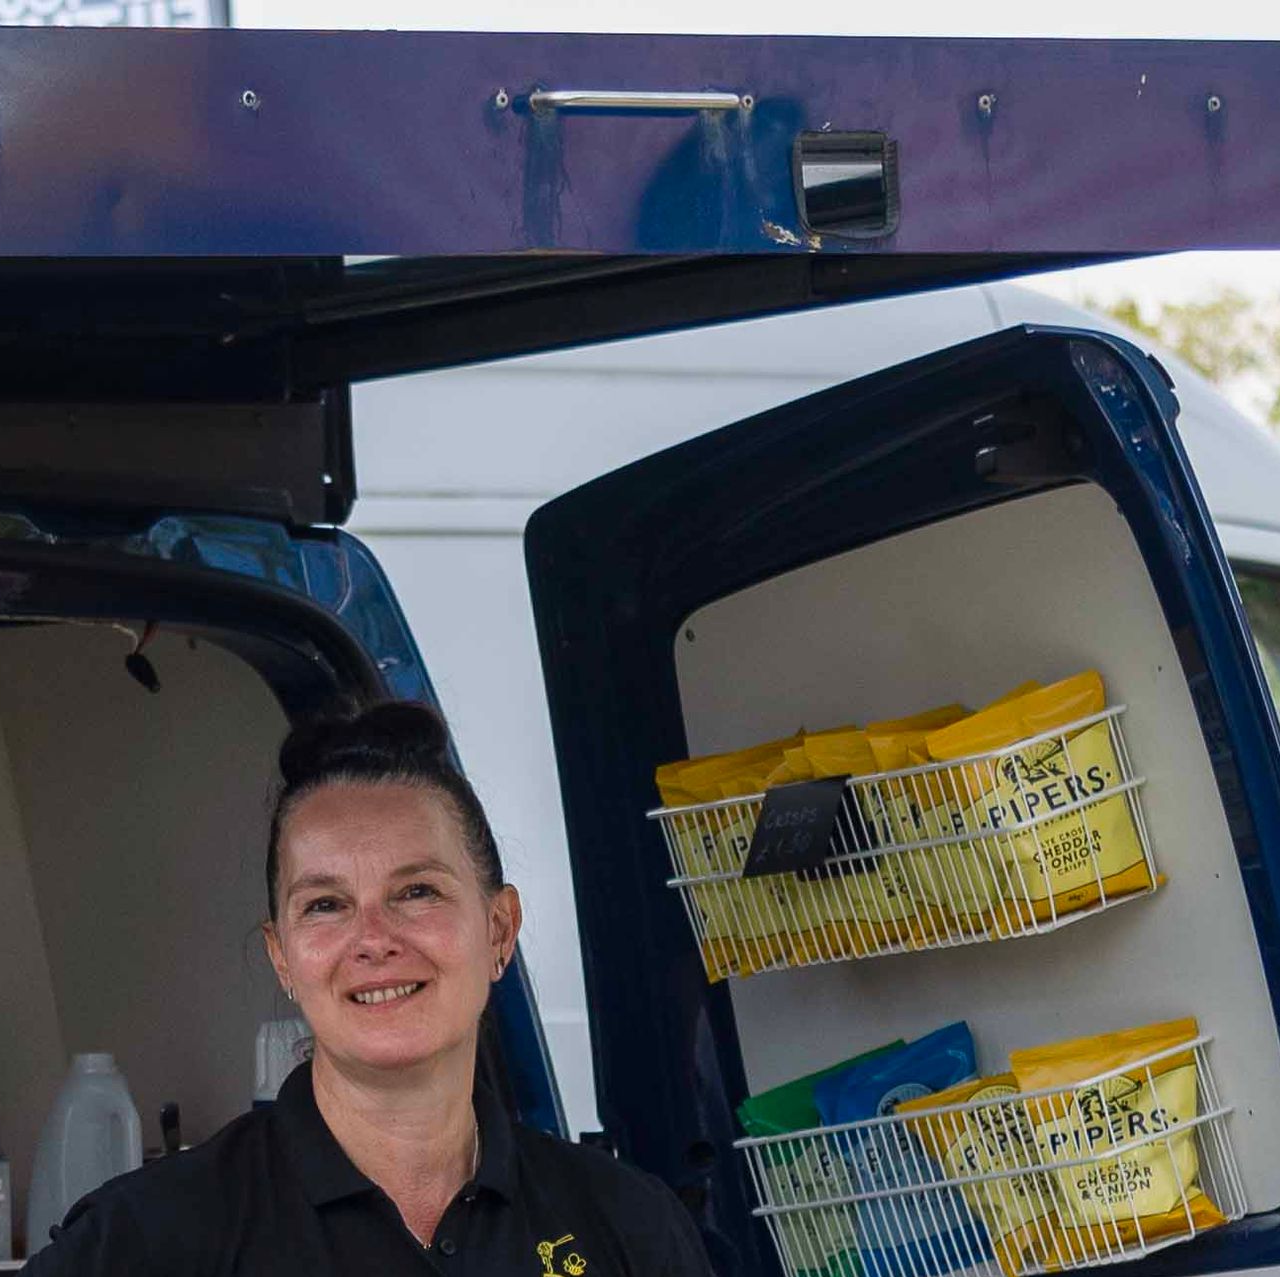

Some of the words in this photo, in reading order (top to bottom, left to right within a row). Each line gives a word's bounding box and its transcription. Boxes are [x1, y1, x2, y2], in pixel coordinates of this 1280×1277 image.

[989, 766, 1106, 829] PIPERS
[1033, 830, 1101, 863] CHEDDAR
[1051, 843, 1101, 868] ONION
[1049, 1109, 1168, 1155] PIPERS
